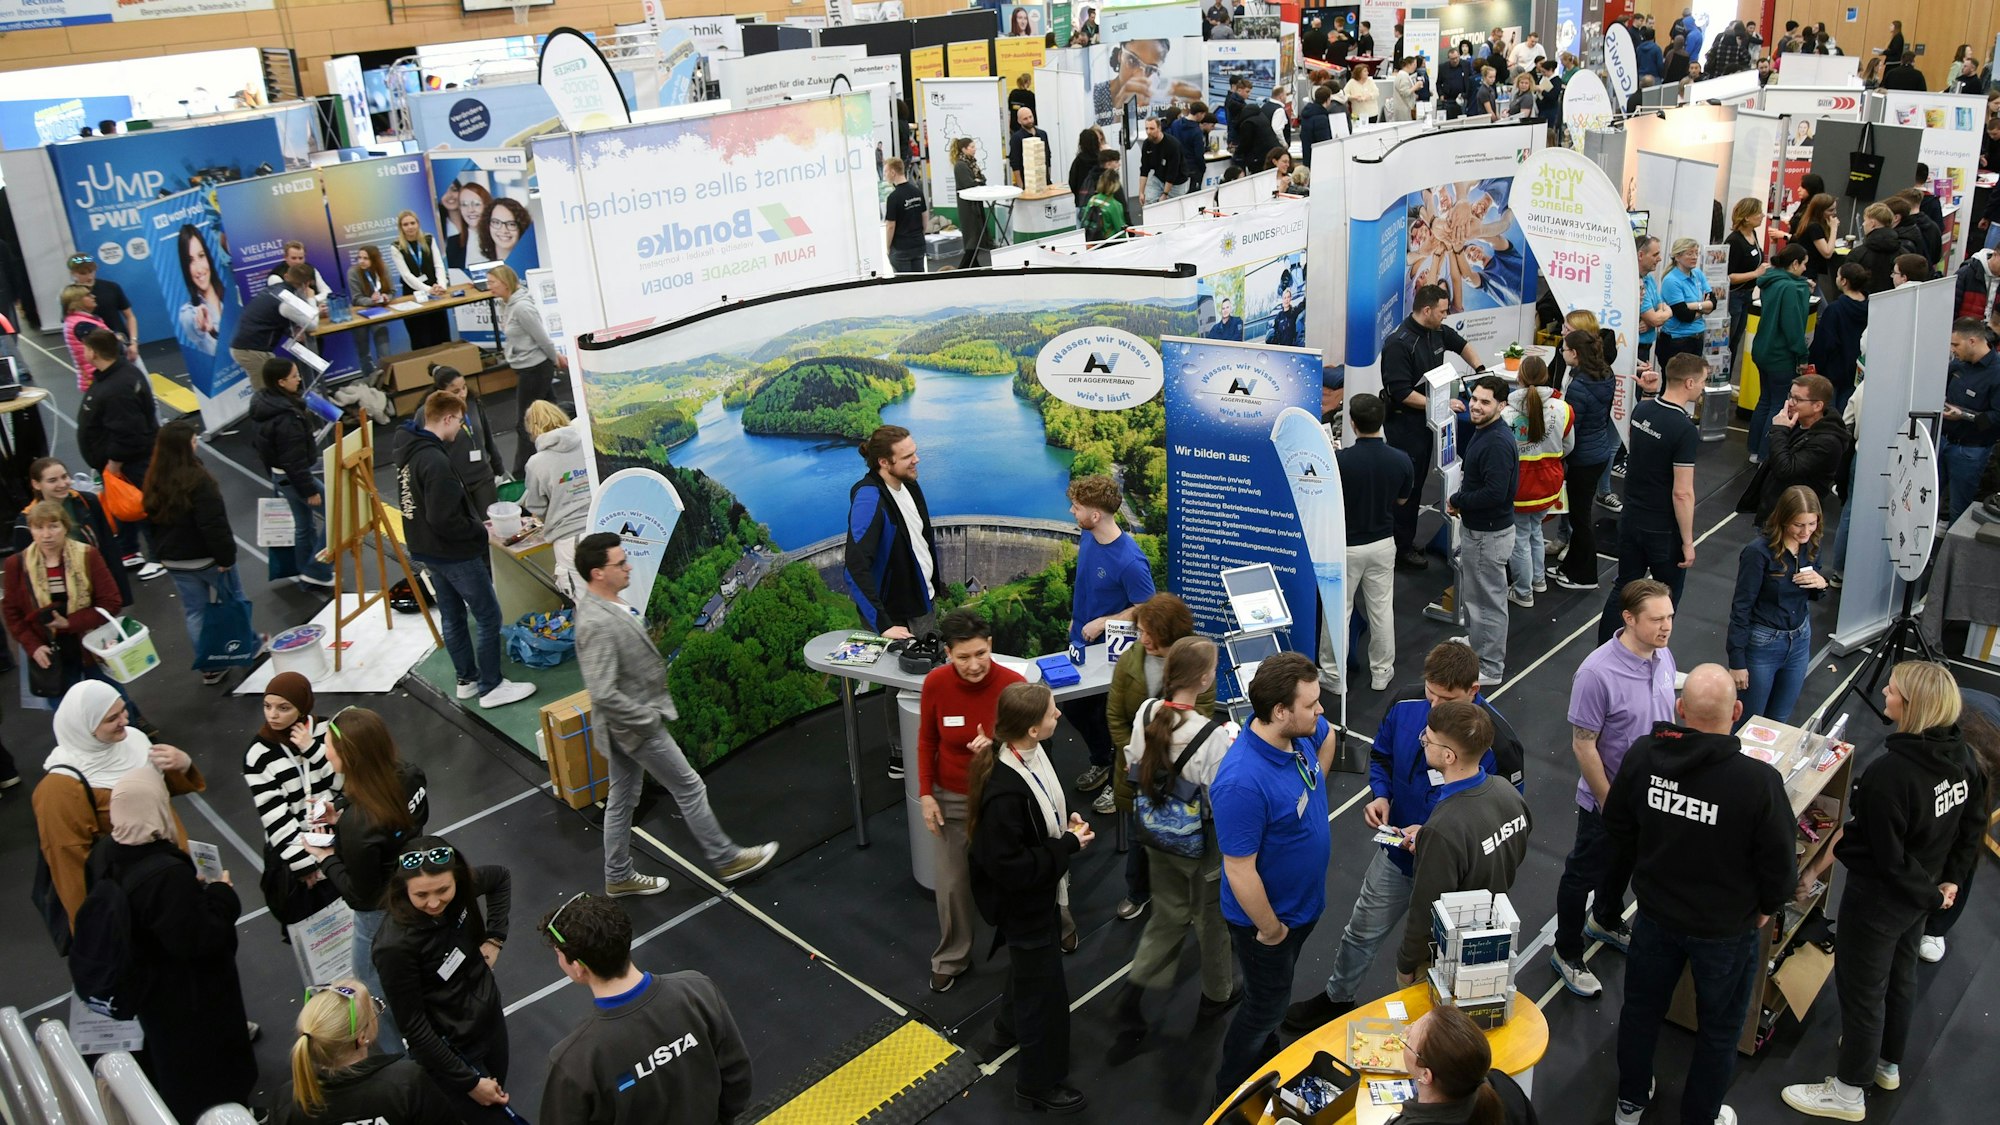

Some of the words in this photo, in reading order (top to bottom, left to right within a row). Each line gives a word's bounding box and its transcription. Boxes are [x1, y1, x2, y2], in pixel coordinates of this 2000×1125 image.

[854, 65, 884, 73] jobcenter
[754, 82, 778, 94] beraten
[779, 79, 790, 88] für
[792, 77, 805, 87] die
[1923, 146, 1971, 158] Verpackungen
[76, 162, 164, 208] JUMP
[1242, 220, 1304, 245] BUNDESPOLIZEI
[240, 239, 283, 256] VIELFALT
[1095, 333, 1115, 344] wir
[1117, 337, 1152, 369] wissen
[1068, 377, 1082, 385] DER
[1083, 377, 1135, 386] AGGERVERBAND
[1235, 362, 1250, 371] wir
[1252, 366, 1280, 393] wissen
[1106, 391, 1132, 403] läuft
[1220, 396, 1262, 406] AGGERVERBAND
[1175, 445, 1192, 456] Wir
[1194, 447, 1226, 461] bilden
[1228, 452, 1251, 463] aus:
[1181, 471, 1227, 482] Bauzeichner/in
[1227, 475, 1251, 486] (m/w/d)
[1181, 480, 1237, 493] Chemielaborant/in
[1238, 485, 1262, 497] (m/w/d)
[1181, 489, 1225, 500] Elektroniker/in
[1181, 498, 1221, 510] Fachrichtung
[1222, 502, 1269, 516] Betriebstechnik
[1270, 509, 1294, 520] (m/w/d)
[1181, 507, 1240, 520] Fachinformatiker/in
[629, 510, 643, 518] wir
[645, 513, 668, 537] wissen
[1181, 515, 1221, 528] Fachrichtung
[1221, 520, 1277, 535] Systemintegration
[1277, 528, 1302, 539] (m/w/d)
[1181, 525, 1240, 538] Fachinformatiker/in
[1181, 533, 1221, 545] Fachrichtung
[1221, 538, 1297, 557] Anwendungsentwicklung
[1181, 542, 1205, 551] (m/w/d)
[1181, 551, 1211, 560] Fachkraft
[1211, 553, 1220, 561] für
[1220, 555, 1270, 568] Abwasserte
[1273, 564, 1297, 574] (m/w/d)
[1181, 559, 1210, 570] Fachkraft
[1211, 562, 1220, 571] für
[1181, 568, 1222, 579] Industrieserv
[1181, 577, 1210, 588] Fachkraft
[1211, 580, 1220, 589] für
[1181, 585, 1229, 598] versorgungstec
[1182, 594, 1216, 605] Forstwirt/in
[1107, 628, 1137, 637] Company
[1650, 775, 1678, 791] TEAM
[1934, 778, 1950, 797] TEAM
[408, 786, 427, 815] STA
[1647, 787, 1719, 825] GIZEH
[1493, 814, 1527, 847] LISTA
[635, 1032, 699, 1079] LISTA
